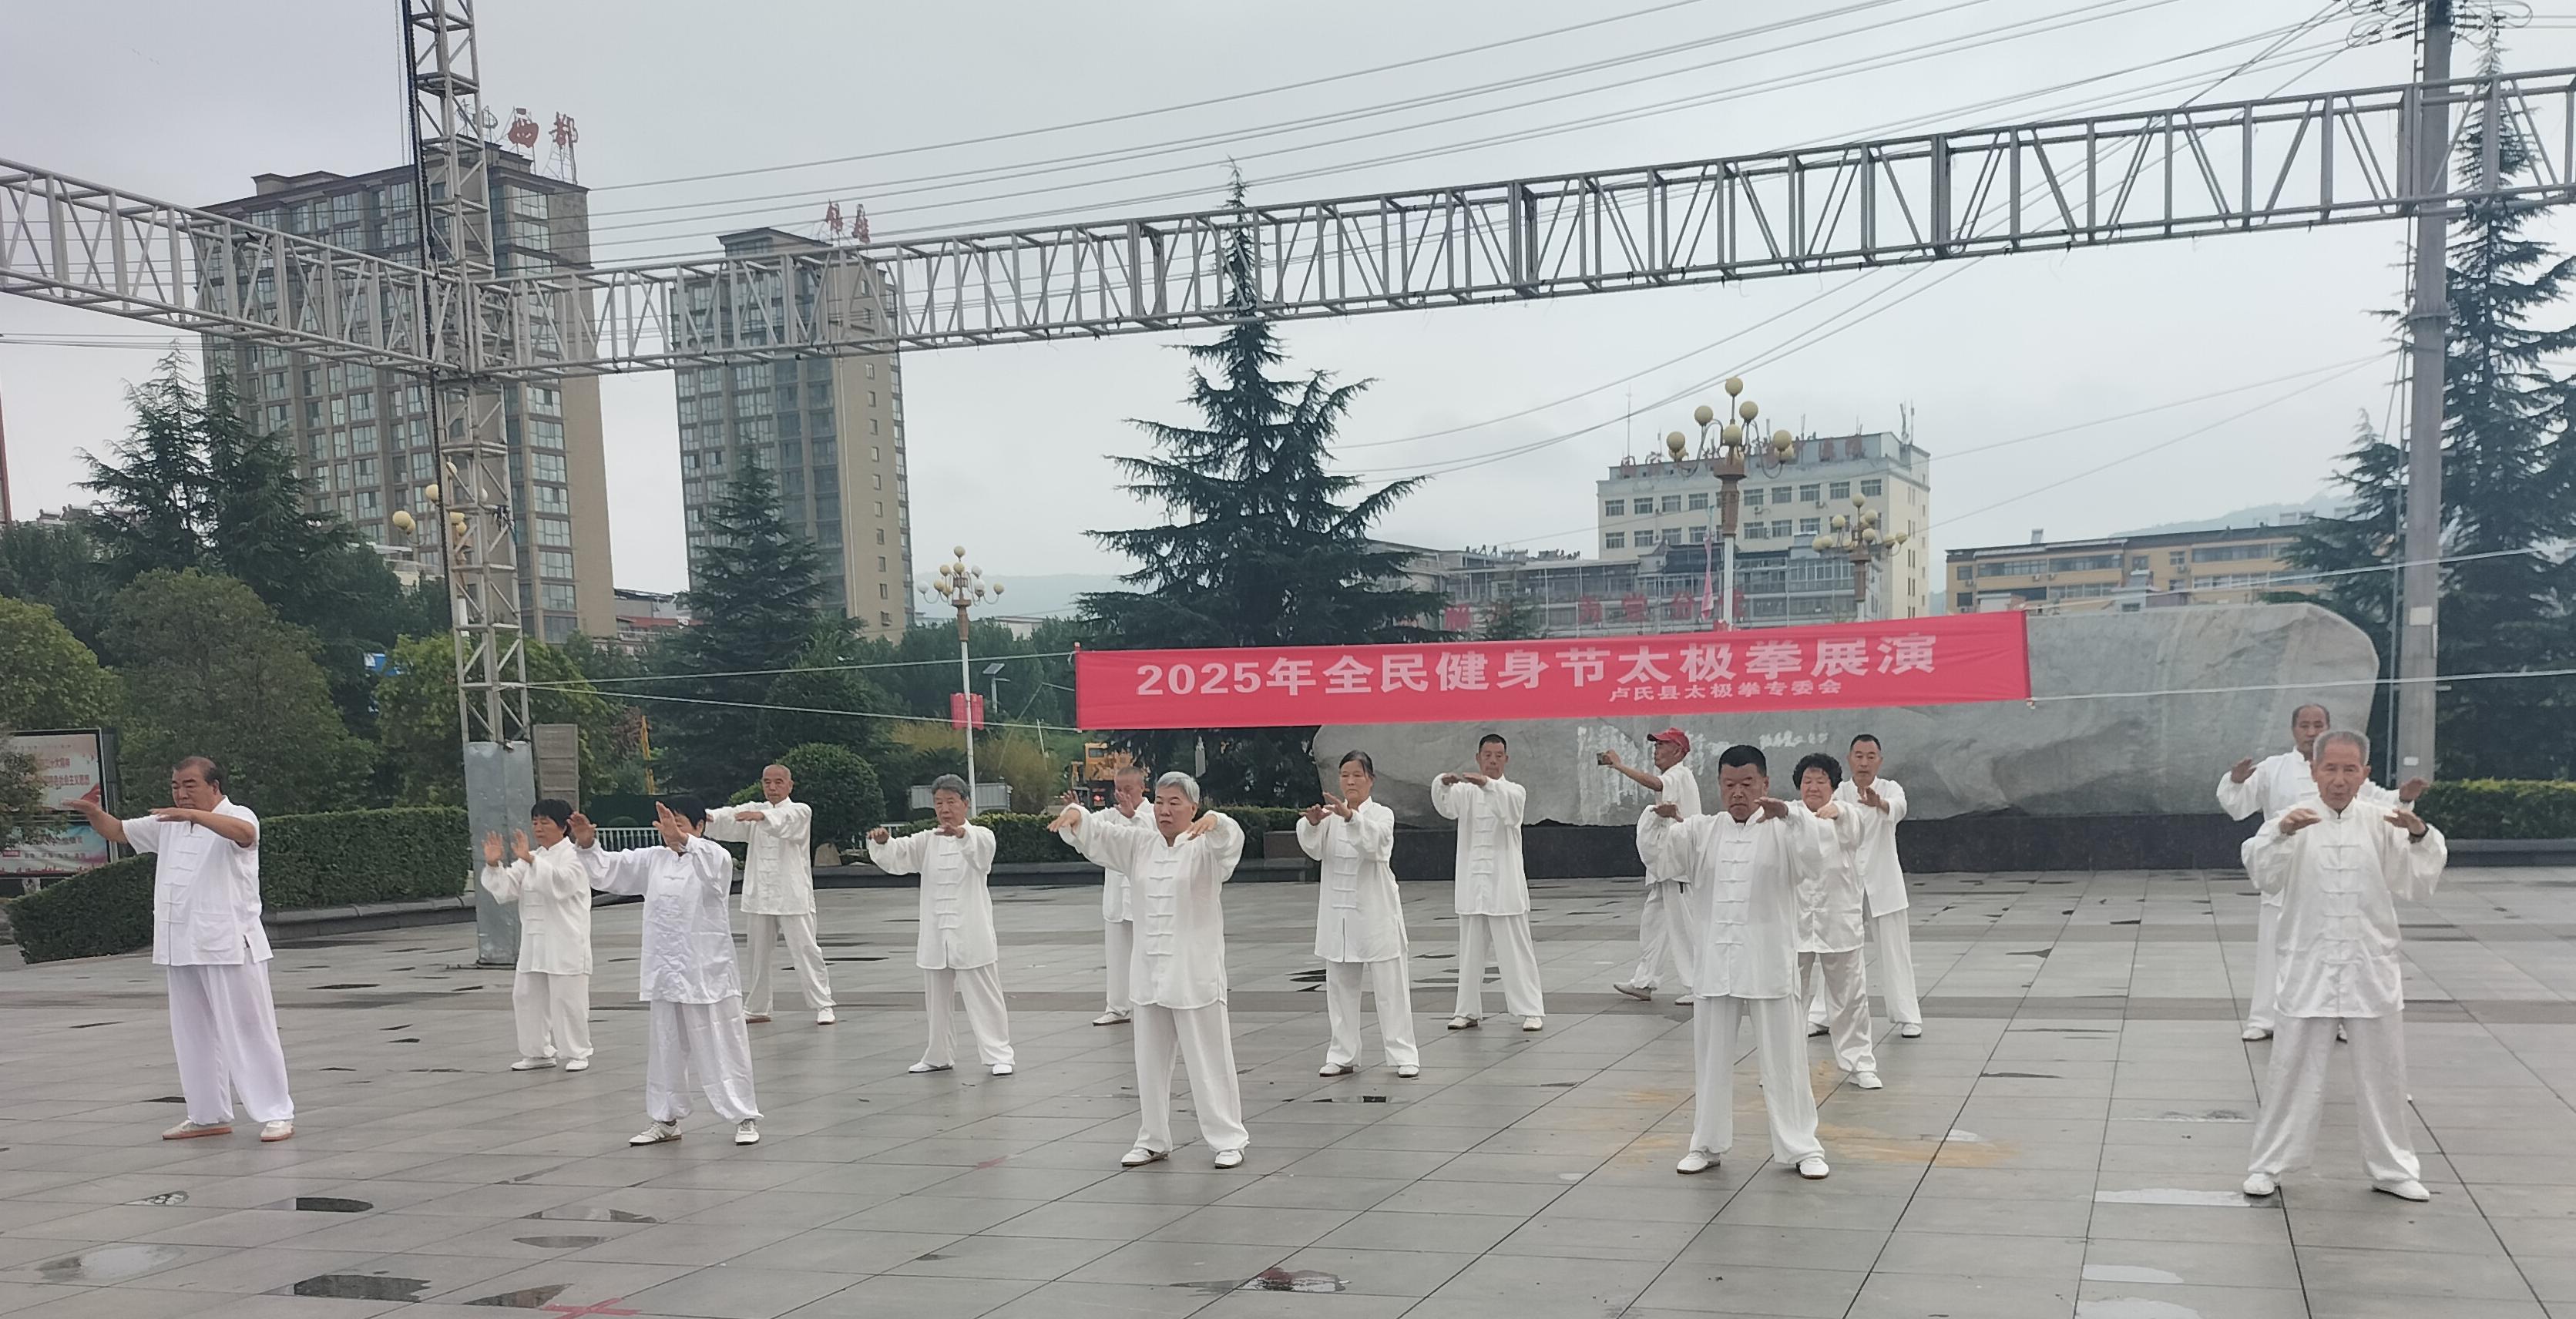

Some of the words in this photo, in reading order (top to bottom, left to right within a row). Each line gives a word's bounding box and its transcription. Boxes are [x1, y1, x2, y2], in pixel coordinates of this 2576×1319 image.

[1137, 633, 1936, 696] 2025年全民健身节太极拳展演
[1609, 679, 1842, 702] 卢氏县太极拳专委会
